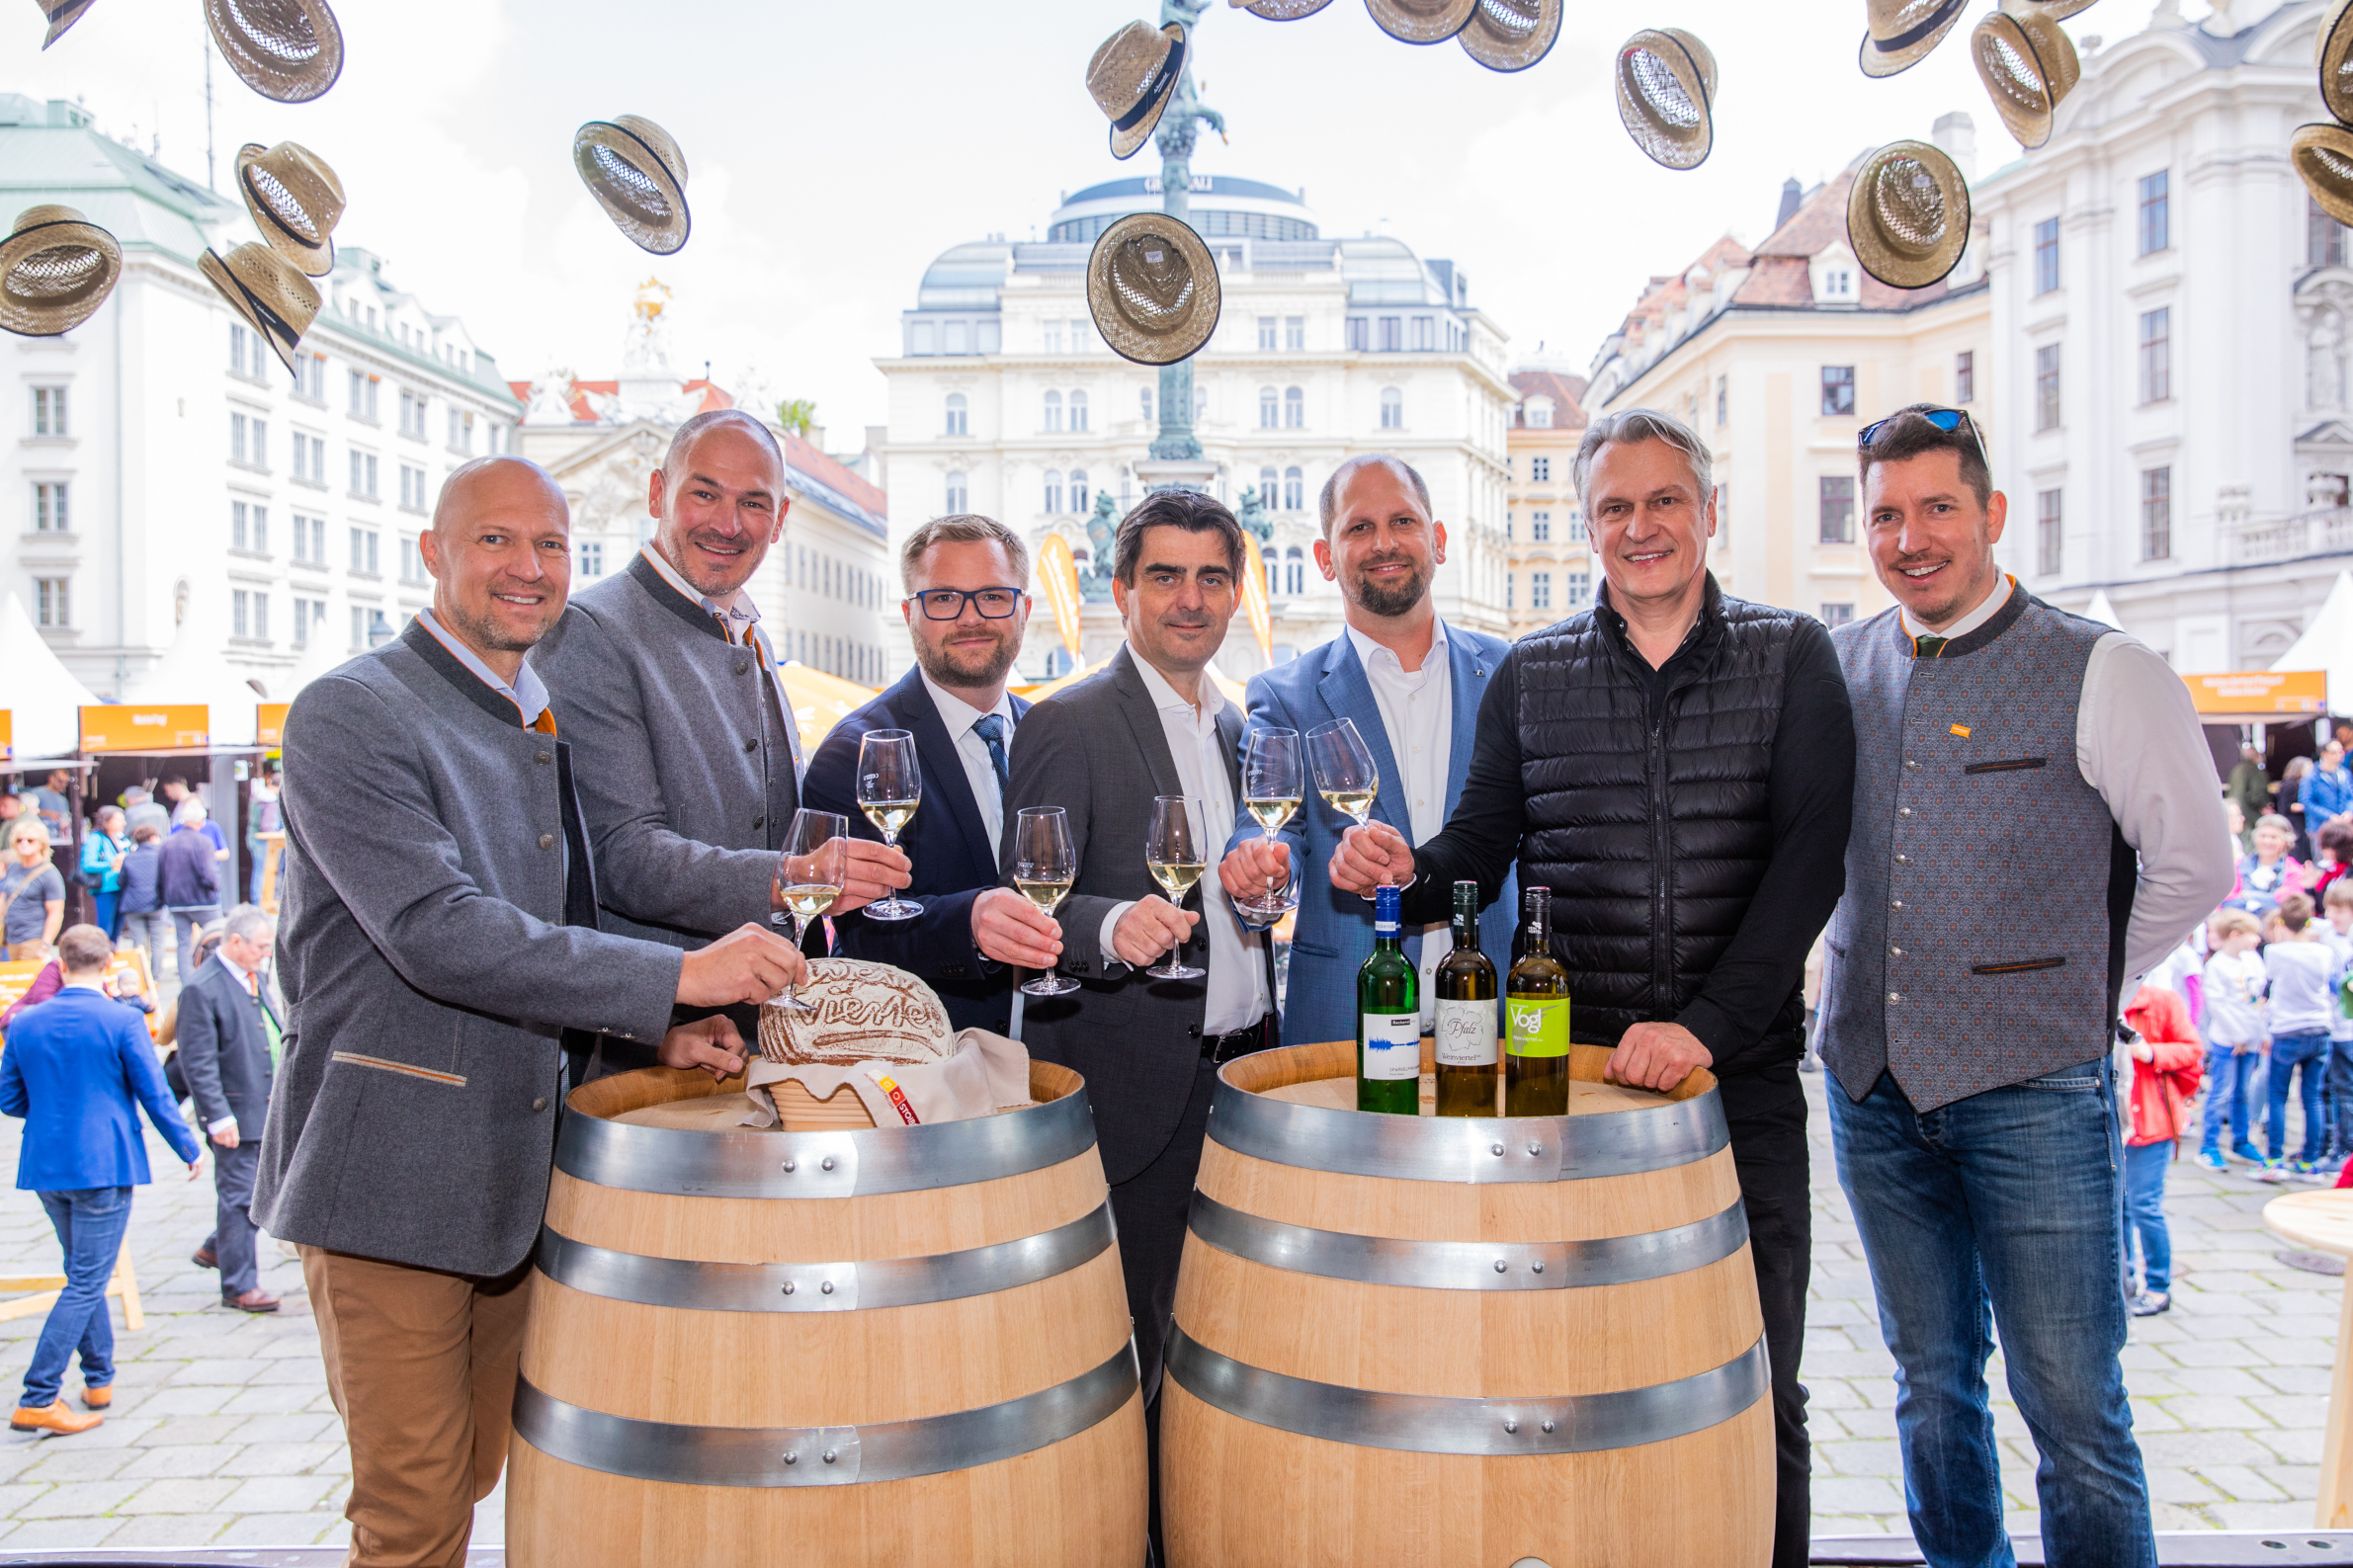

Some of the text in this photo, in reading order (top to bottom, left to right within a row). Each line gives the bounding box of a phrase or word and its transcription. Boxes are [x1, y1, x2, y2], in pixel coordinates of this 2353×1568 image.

[1144, 176, 1213, 192] GEALI
[1510, 1006, 1542, 1034] Vogl
[1449, 1022, 1476, 1038] Pfalz
[1442, 1052, 1476, 1061] Weinviertel
[898, 1103, 917, 1125] STOIB
